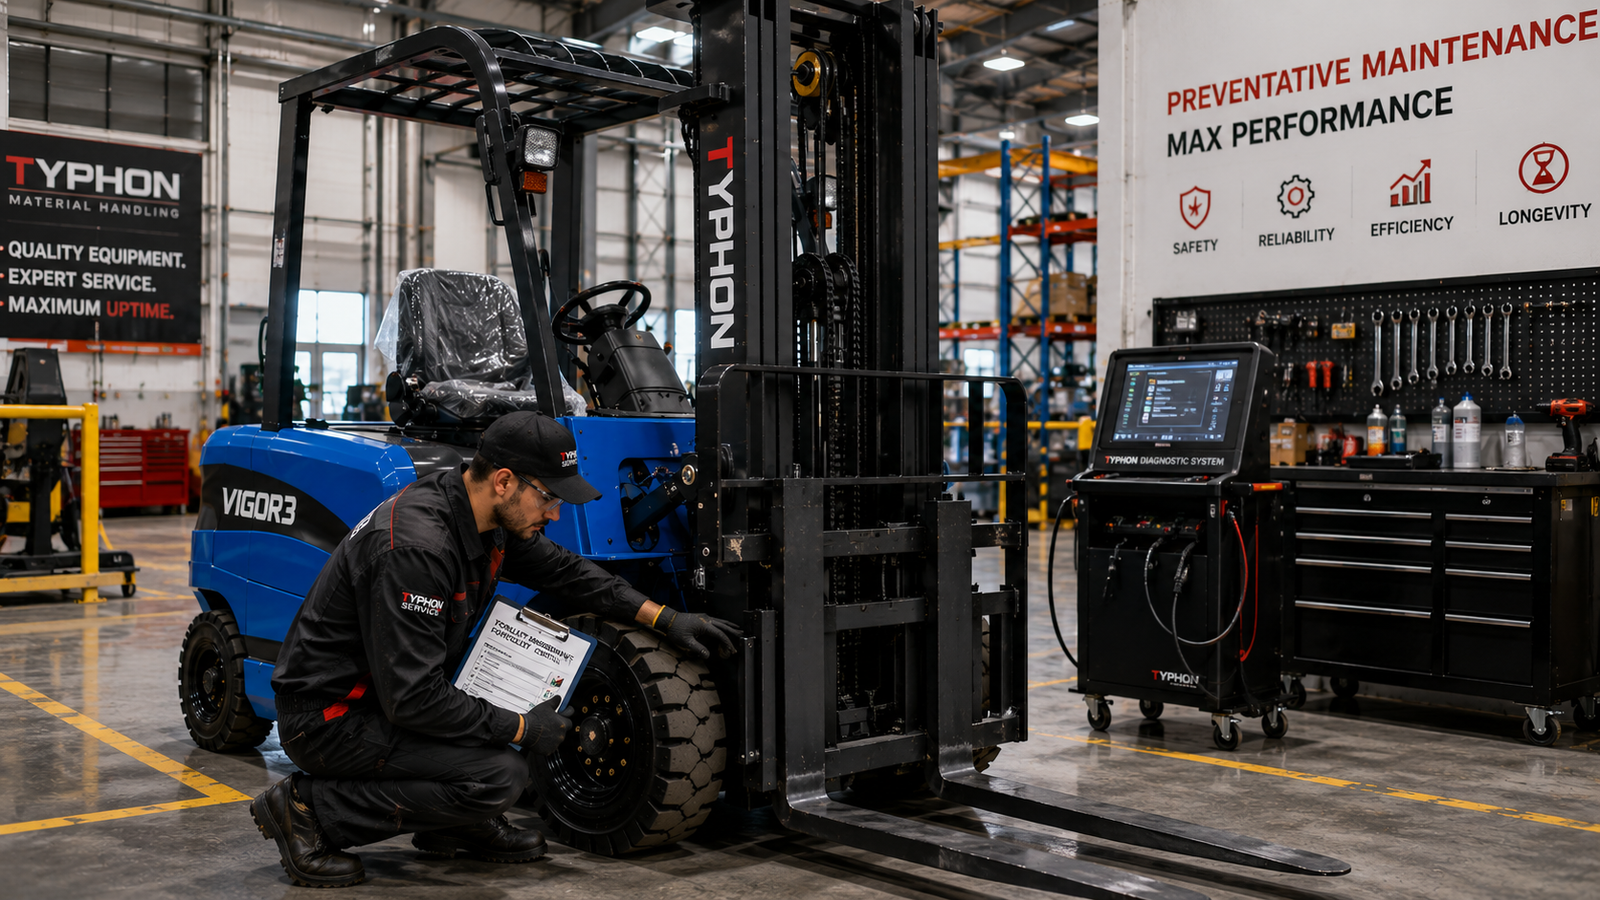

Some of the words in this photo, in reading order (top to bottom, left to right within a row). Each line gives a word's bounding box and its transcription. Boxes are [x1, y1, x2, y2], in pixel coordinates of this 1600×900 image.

[1167, 57, 1351, 115] PREVENTATIVE
[1362, 9, 1599, 80] MAINTENANCE
[1167, 125, 1223, 157] MAX
[1232, 86, 1453, 147] PERFORMANCE
[6, 155, 180, 200] TYPHON
[9, 194, 92, 212] MATERIAL
[99, 202, 179, 219] HANDLING
[1499, 203, 1592, 226] LONGEVITY
[1258, 228, 1335, 247] RELIABILITY
[1370, 216, 1454, 237] EFFICIENCY
[8, 240, 84, 261] QUALITY
[88, 246, 186, 269] EQUIPMENT.
[708, 136, 735, 349] TYPHON
[1173, 239, 1218, 255] SAFETY
[8, 268, 77, 288] EXPERT
[82, 272, 156, 292] SERVICE.
[8, 296, 101, 316] MAXIMUM
[106, 301, 174, 320] UPTIME.
[1105, 456, 1138, 464] TYPHON
[1140, 456, 1189, 465] DIAGNOSTIC
[1190, 457, 1225, 466] SYSTEM
[222, 487, 297, 526] VIGOR3
[402, 592, 444, 609] TYPHON
[1151, 670, 1199, 684] TYPHON
